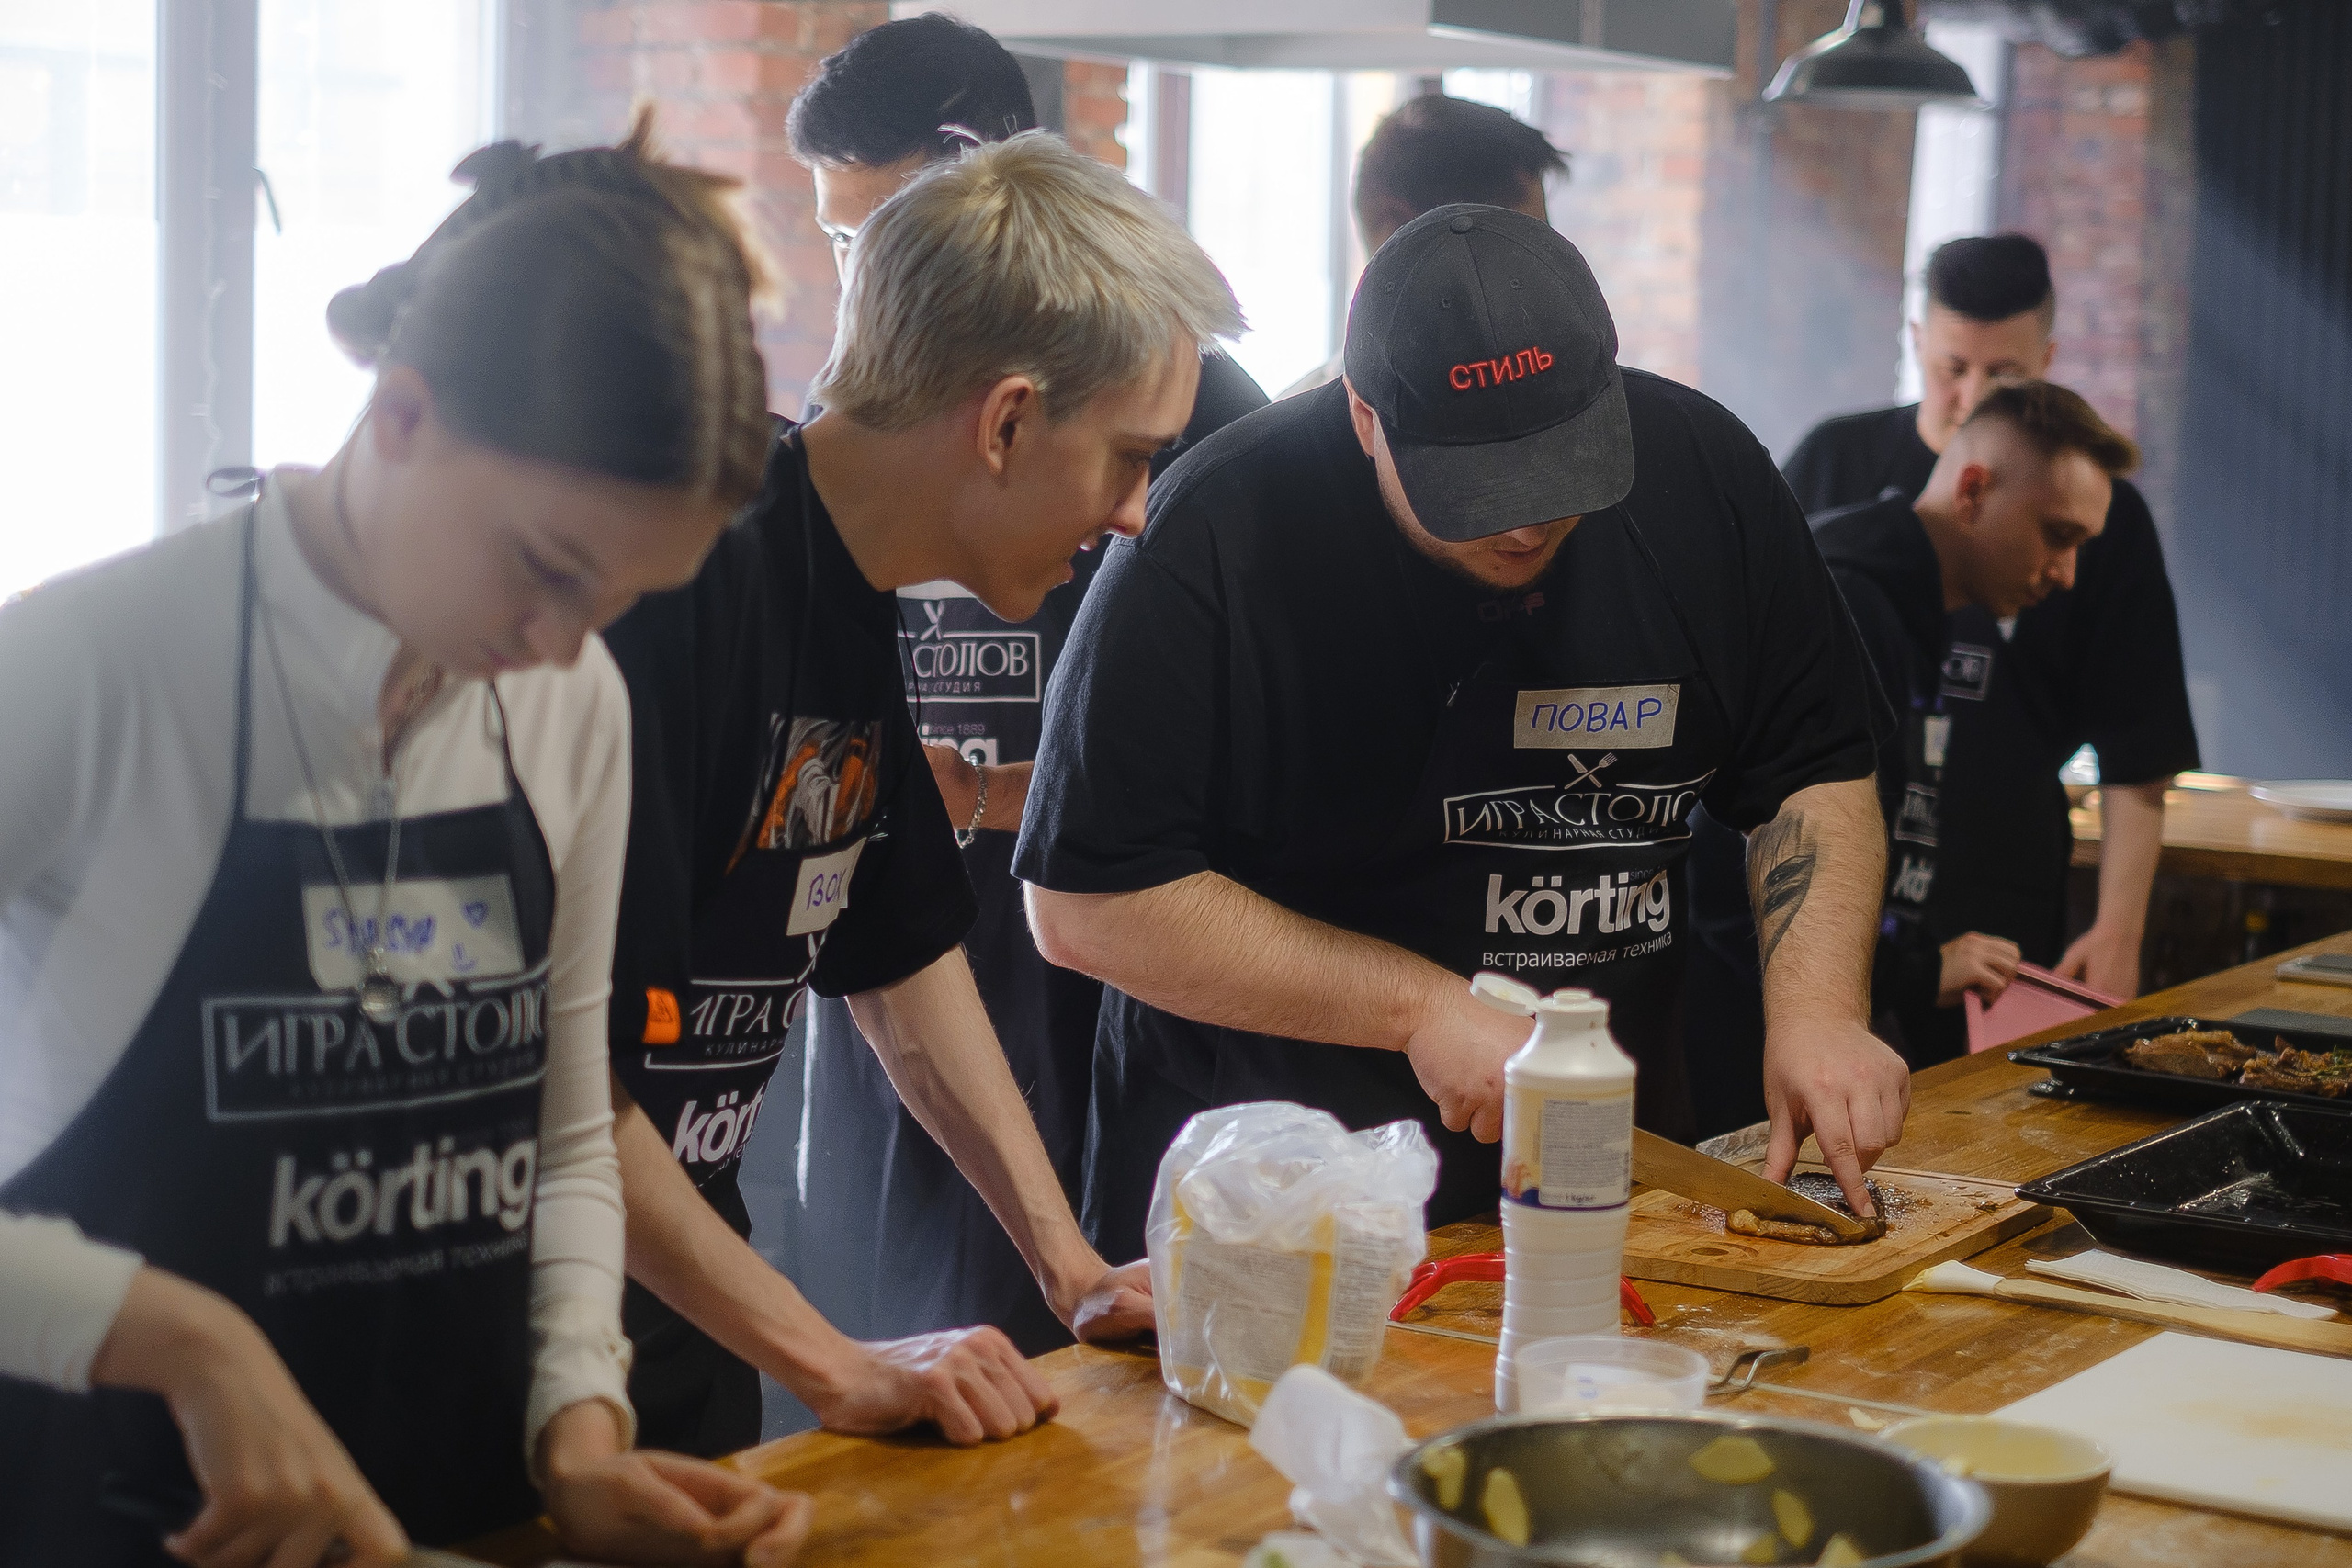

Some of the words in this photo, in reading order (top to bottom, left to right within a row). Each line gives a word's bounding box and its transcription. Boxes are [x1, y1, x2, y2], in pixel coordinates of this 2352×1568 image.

[1449, 345, 1555, 391] СТИЛЬ
[912, 641, 1030, 679] СТОЛОВ
[1531, 697, 1663, 733] ПОВАР
[1485, 870, 1671, 935] körting
[1482, 946, 1617, 972] встраиваемая
[1623, 931, 1673, 960] техника
[269, 1135, 538, 1249] körting
